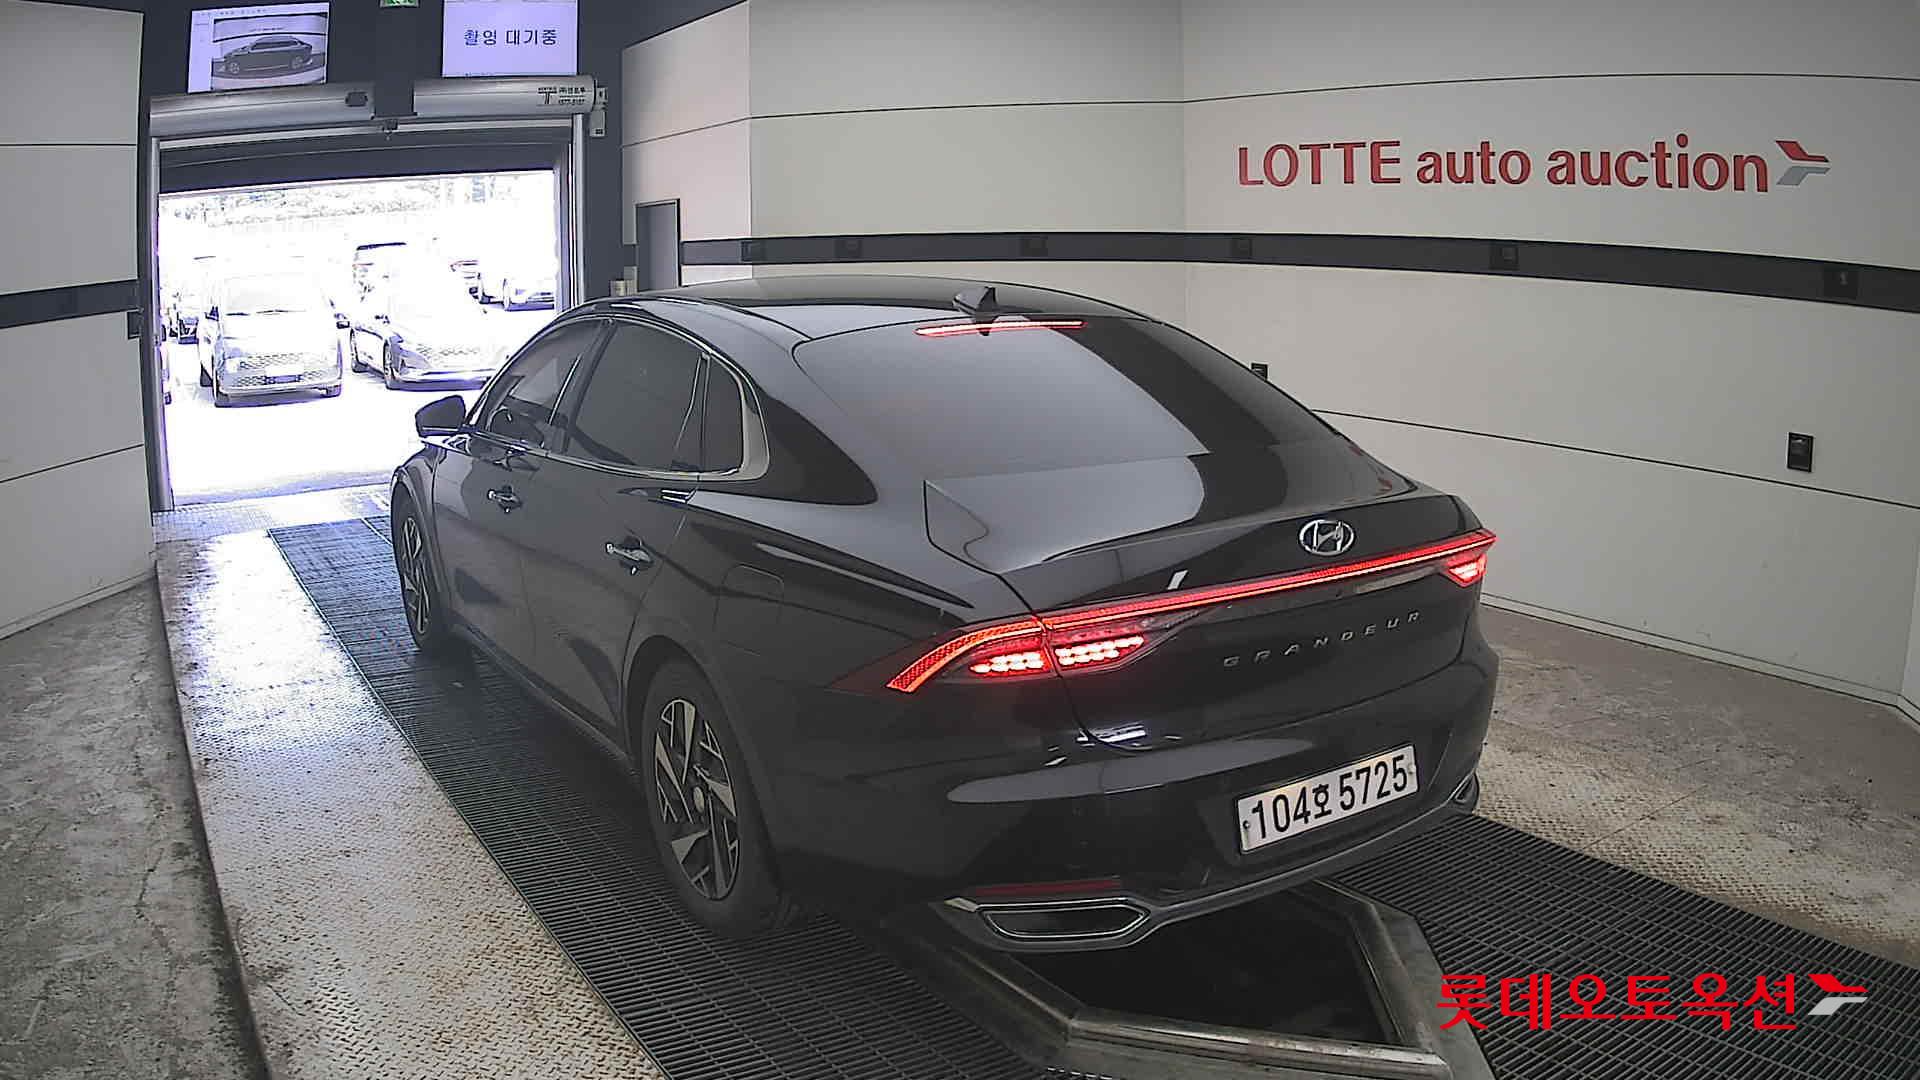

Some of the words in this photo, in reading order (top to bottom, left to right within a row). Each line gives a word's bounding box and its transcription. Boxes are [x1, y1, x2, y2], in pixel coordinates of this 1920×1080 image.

[505, 29, 557, 46] 대기중
[1239, 140, 1400, 187] LOTTE
[1416, 140, 1532, 185] auto
[1547, 133, 1768, 192] auction
[1223, 610, 1420, 667] GRANDEUR
